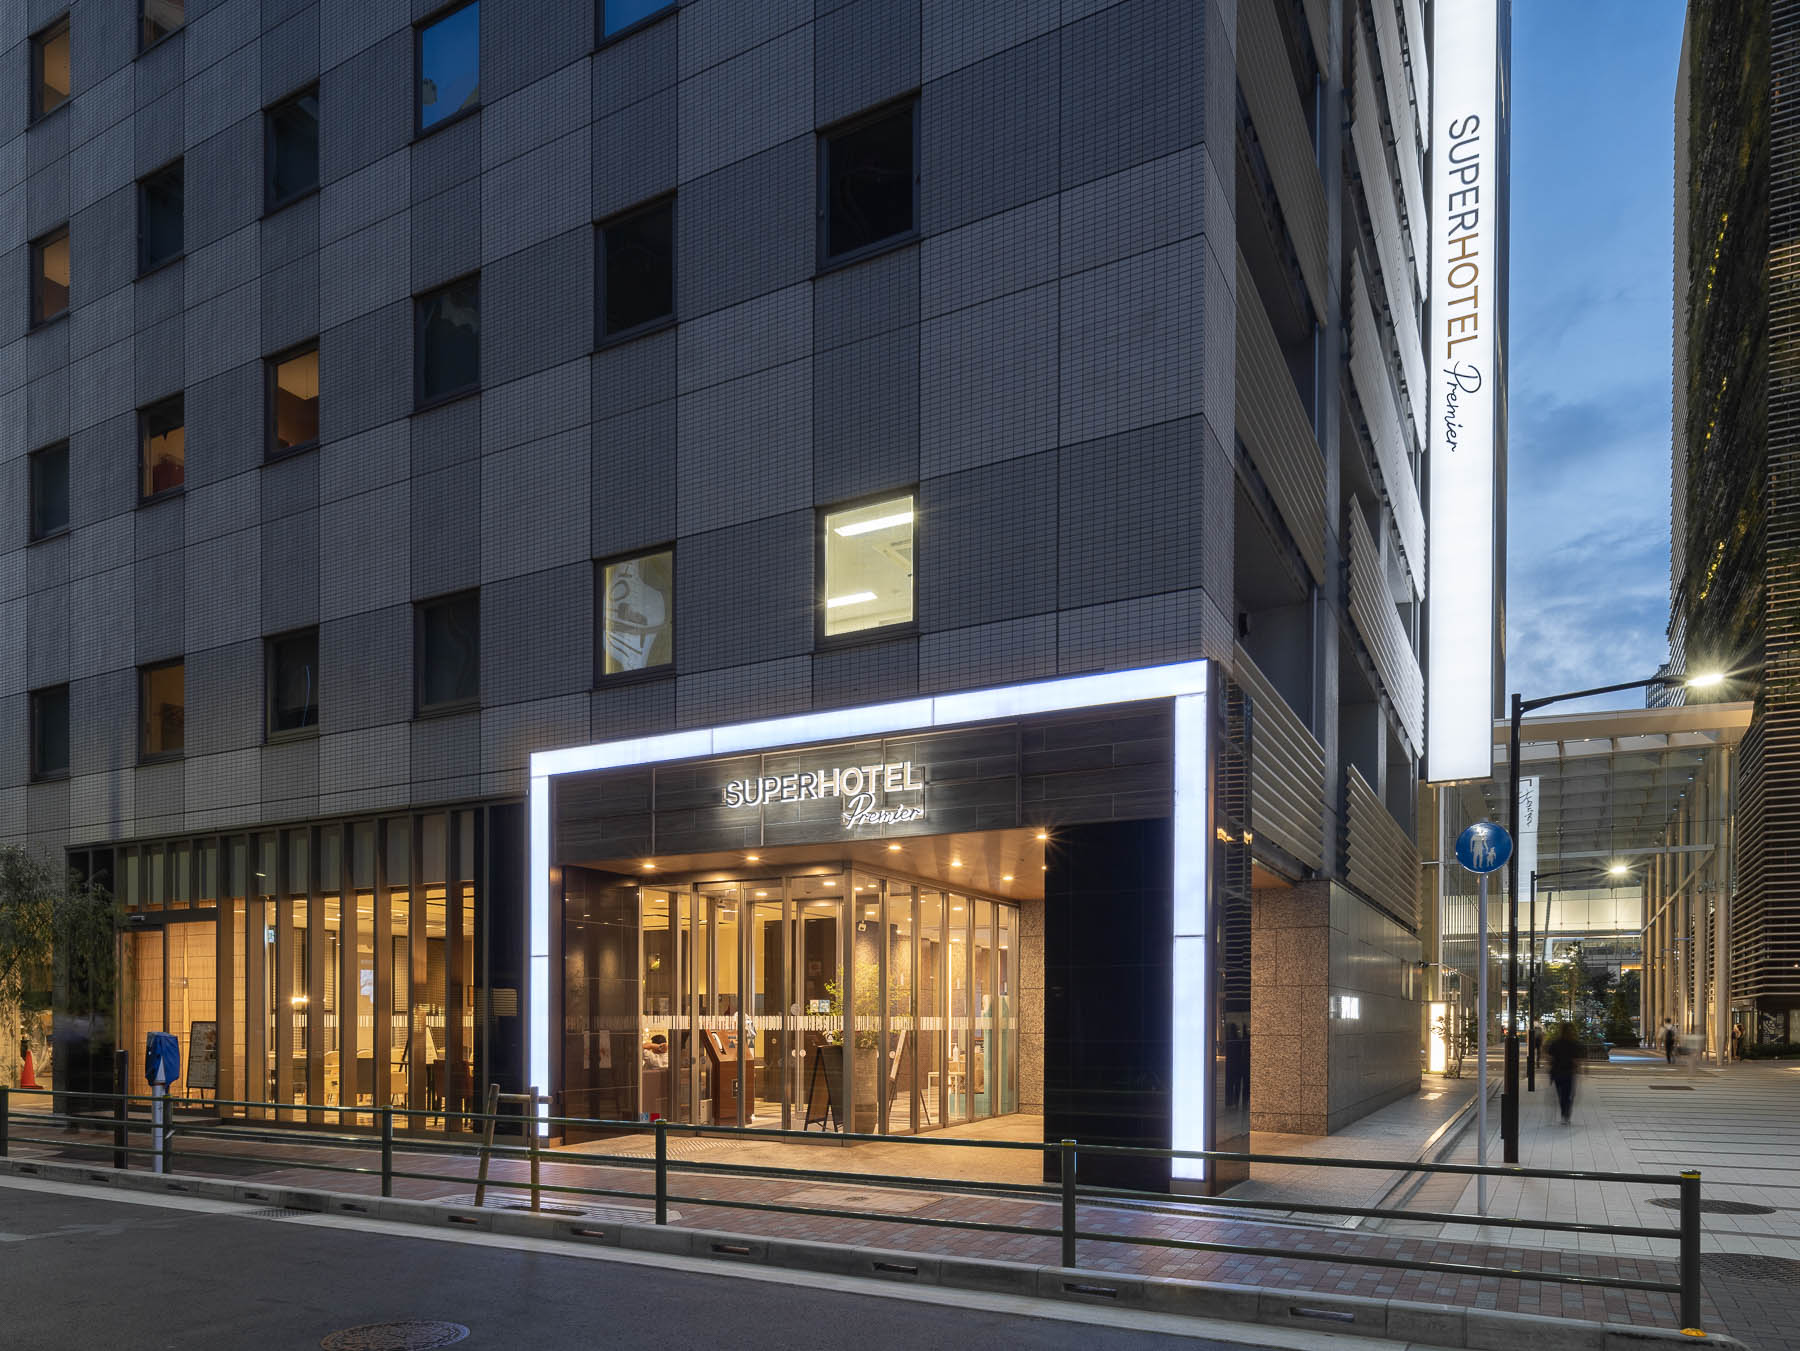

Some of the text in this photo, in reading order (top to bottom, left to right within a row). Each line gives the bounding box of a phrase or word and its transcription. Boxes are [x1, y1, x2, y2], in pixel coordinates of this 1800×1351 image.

[1443, 114, 1482, 453] SUPERHOTEL Premier
[725, 761, 924, 809] SUPERHOTEL
[842, 792, 924, 830] Premier
